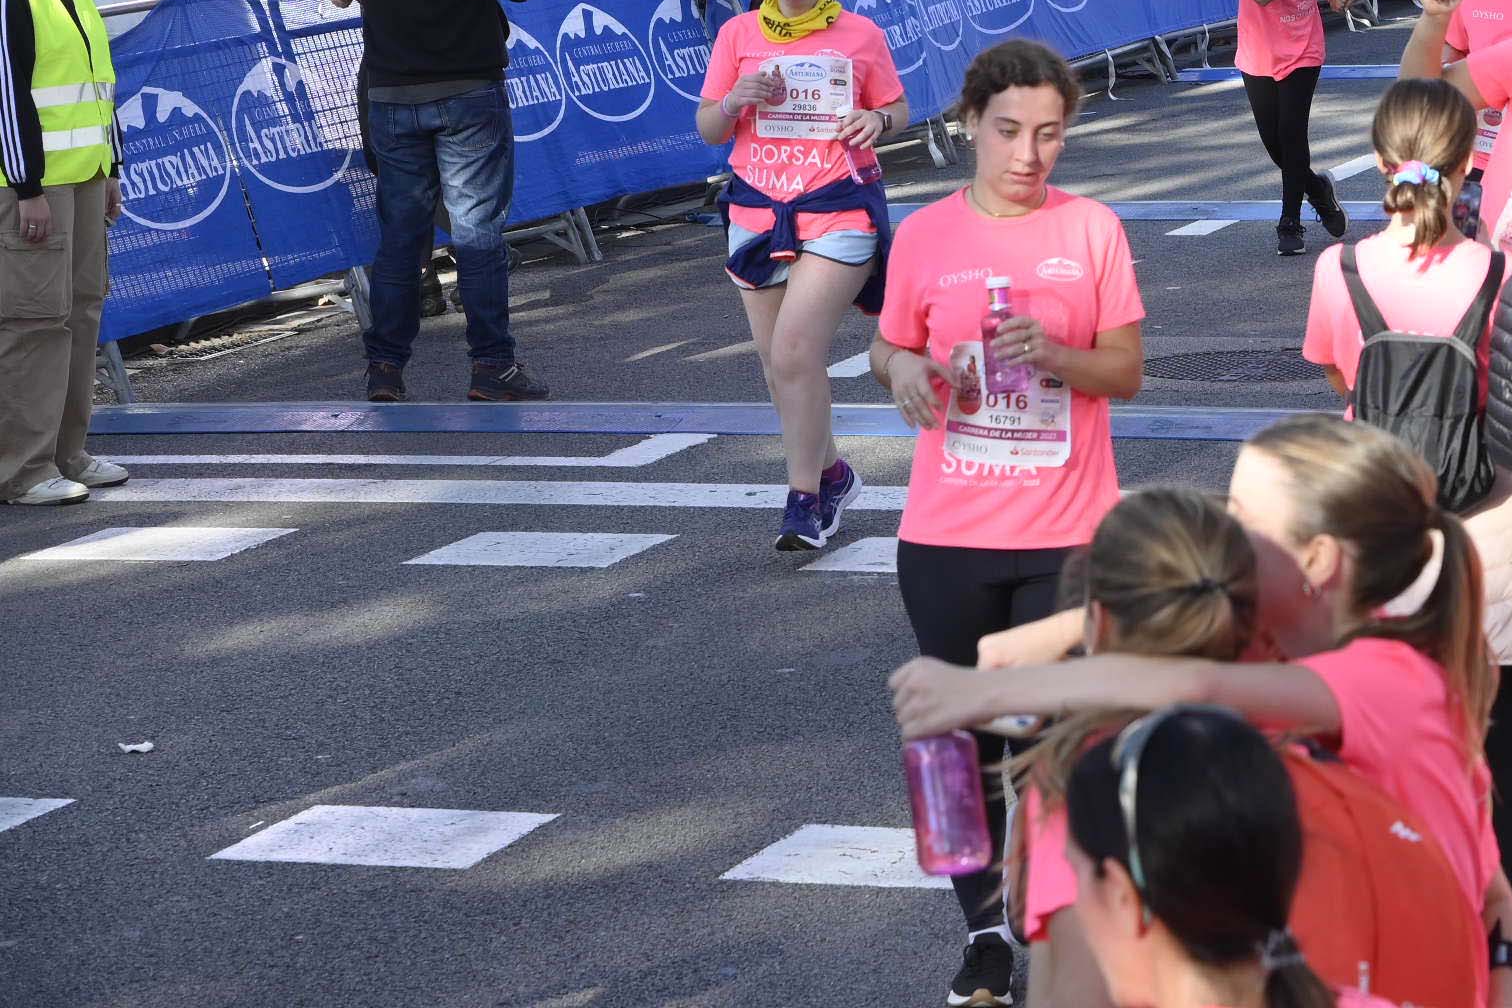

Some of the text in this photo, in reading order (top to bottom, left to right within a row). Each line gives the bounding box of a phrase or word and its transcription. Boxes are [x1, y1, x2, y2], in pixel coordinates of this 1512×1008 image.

[564, 51, 651, 97] ASTURIANA
[789, 87, 822, 101] 016
[792, 103, 817, 112] 29836
[764, 124, 794, 133] OYSHO
[750, 143, 833, 169] DORSAL
[118, 141, 225, 202] ASTURIANA
[745, 165, 806, 193] SUMA
[939, 267, 993, 288] OYSHO
[985, 392, 1028, 410] 016
[988, 414, 1022, 425] 16791
